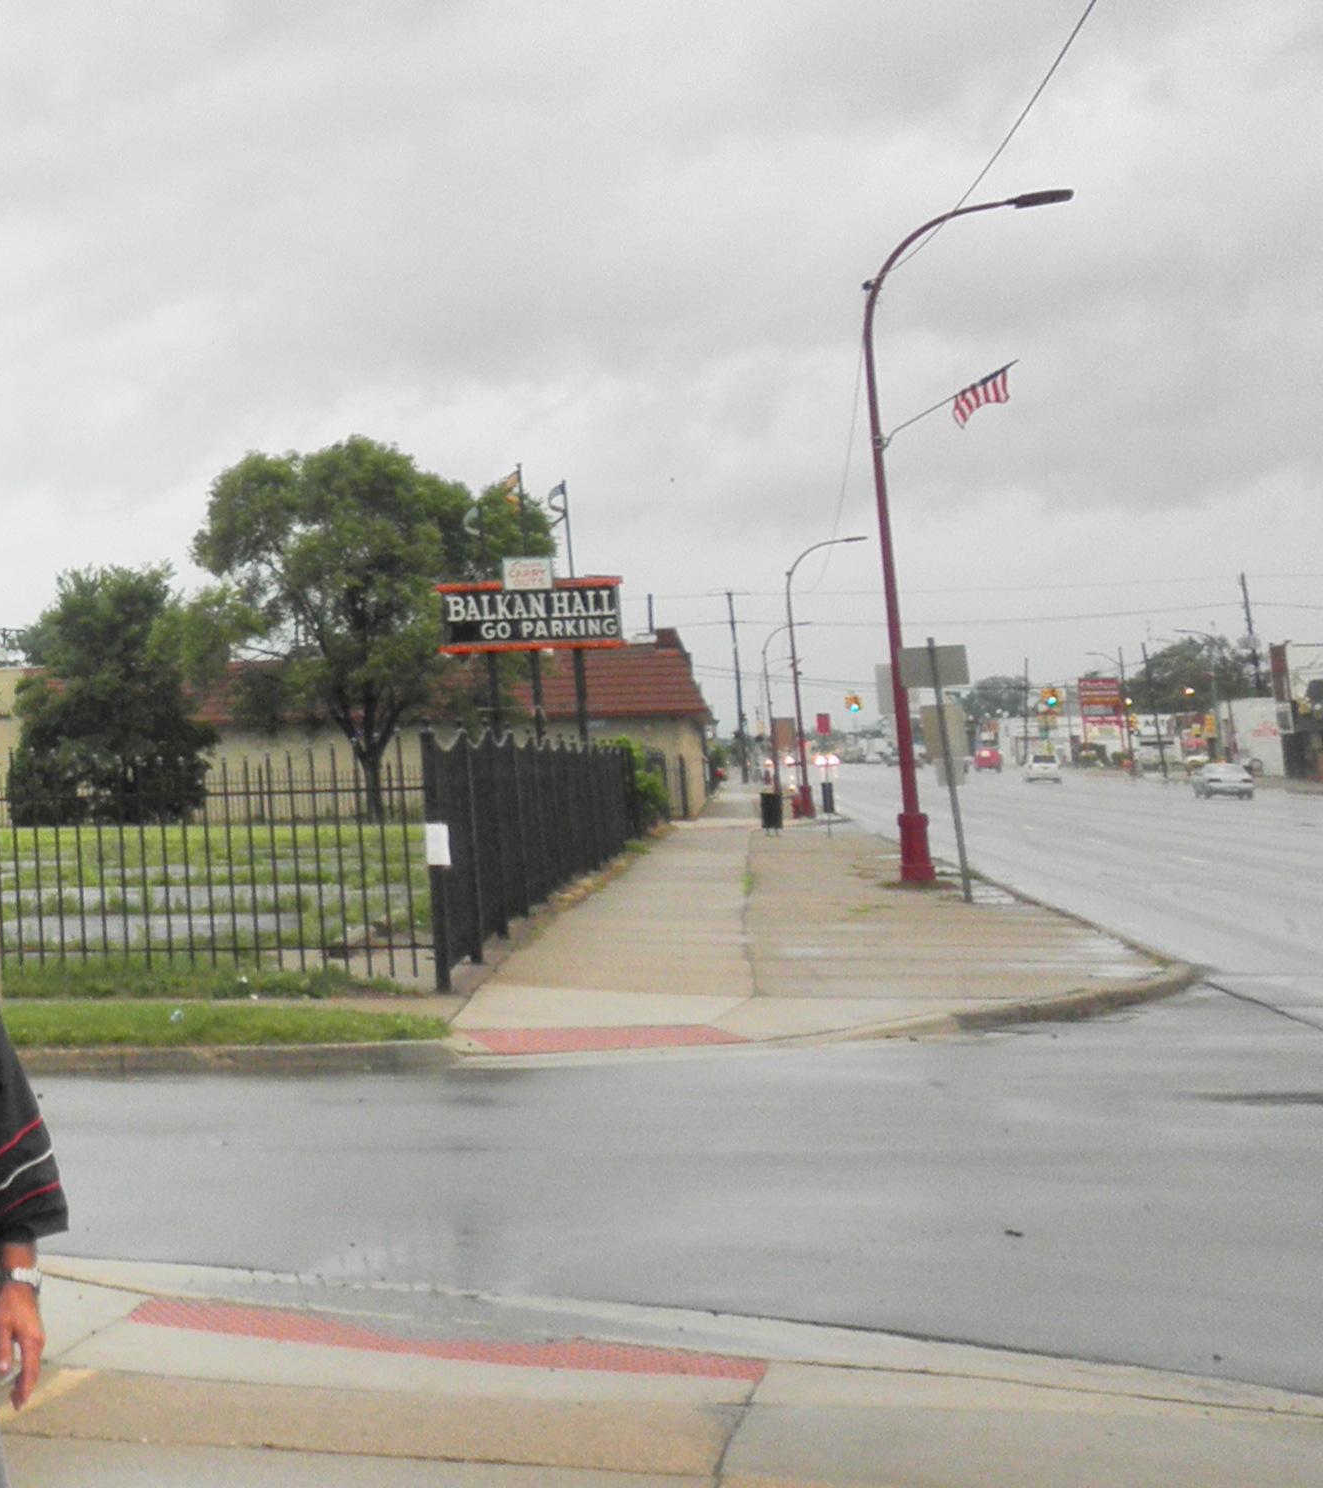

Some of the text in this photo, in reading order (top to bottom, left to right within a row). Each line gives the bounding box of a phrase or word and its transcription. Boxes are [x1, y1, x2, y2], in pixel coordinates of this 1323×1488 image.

[445, 589, 618, 622] BALKAN HALL
[480, 617, 618, 640] GO PARKING
